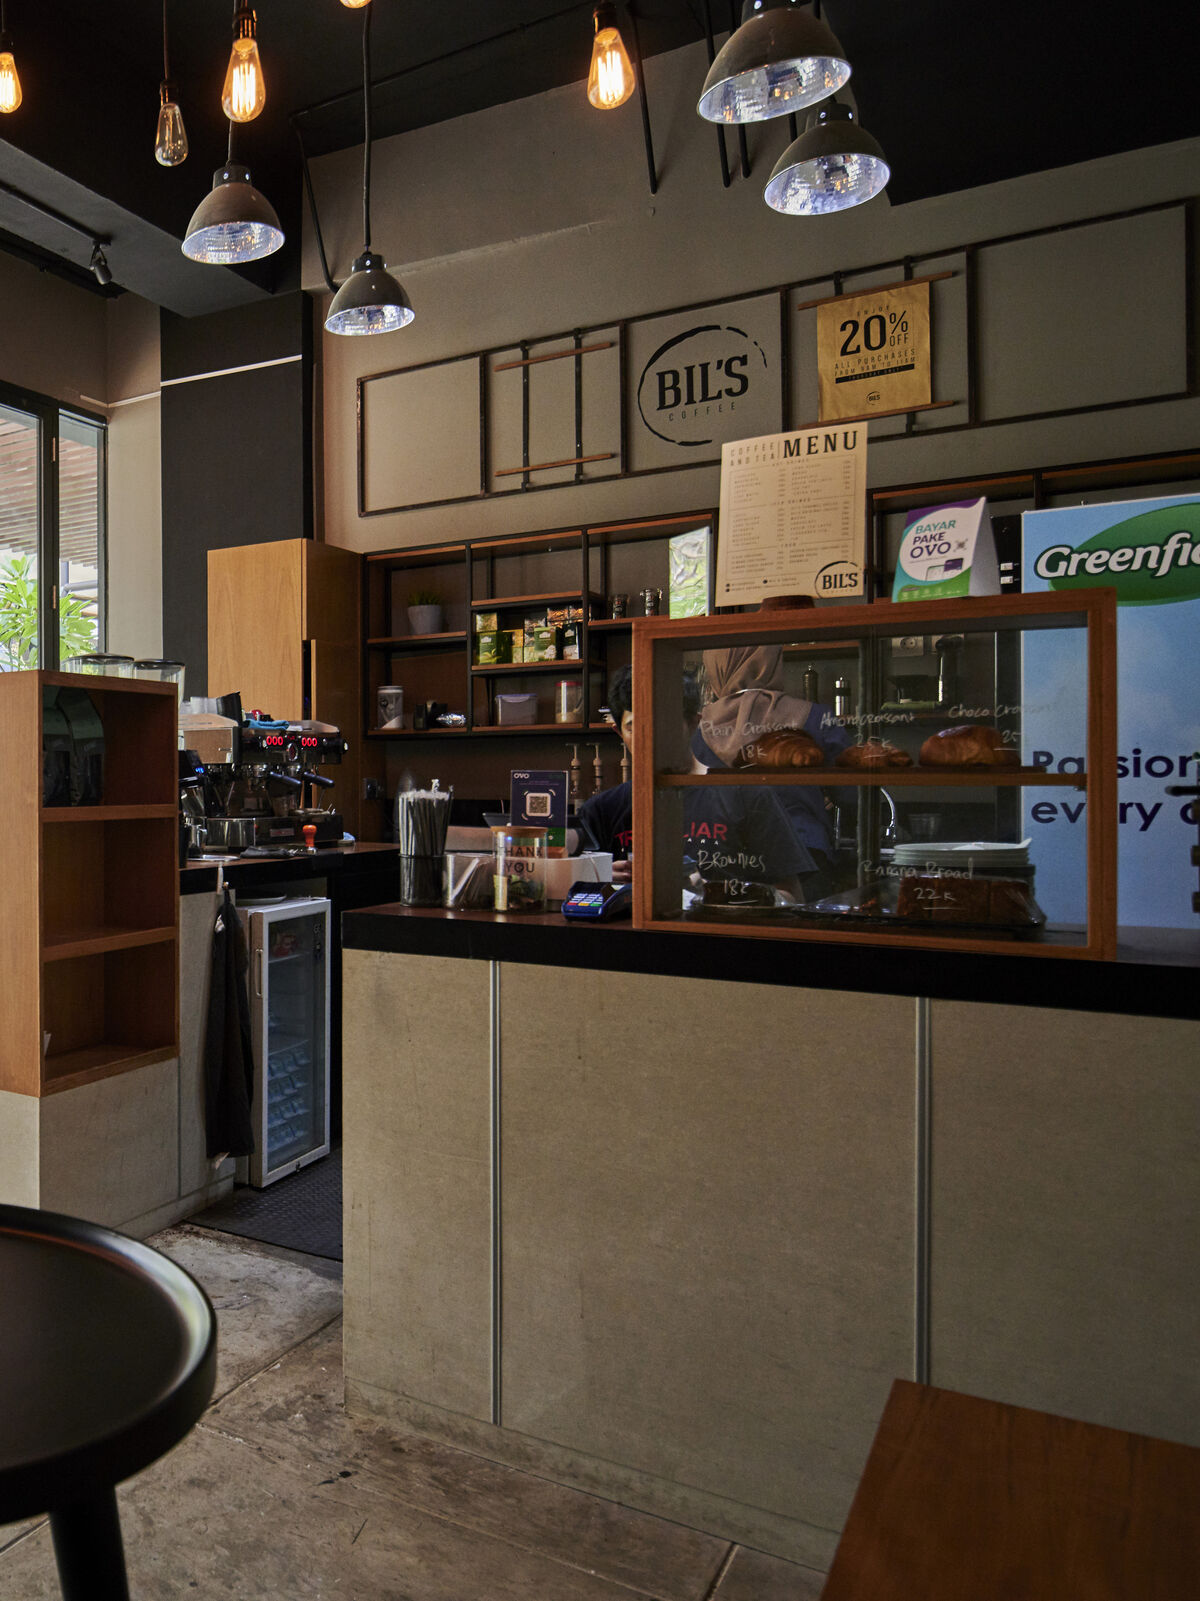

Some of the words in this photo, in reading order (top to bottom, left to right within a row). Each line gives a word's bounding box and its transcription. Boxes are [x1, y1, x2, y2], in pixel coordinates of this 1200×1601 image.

[840, 310, 909, 357] 20%
[889, 332, 910, 348] OFF
[834, 359, 851, 370] ALL
[857, 347, 917, 366] PURCHASES
[656, 353, 750, 412] BIL'S
[668, 403, 737, 423] COFFEE
[730, 441, 775, 458] COFFEE
[783, 430, 859, 459] MENU
[730, 455, 751, 467] AND
[755, 452, 776, 464] TEA
[915, 519, 957, 535] BAYAR
[912, 531, 947, 546] PAKE
[910, 541, 953, 559] OVO
[821, 572, 859, 591] BIL'S
[513, 772, 531, 780] OVO
[1030, 801, 1164, 832] evry
[504, 860, 536, 874] YOU
